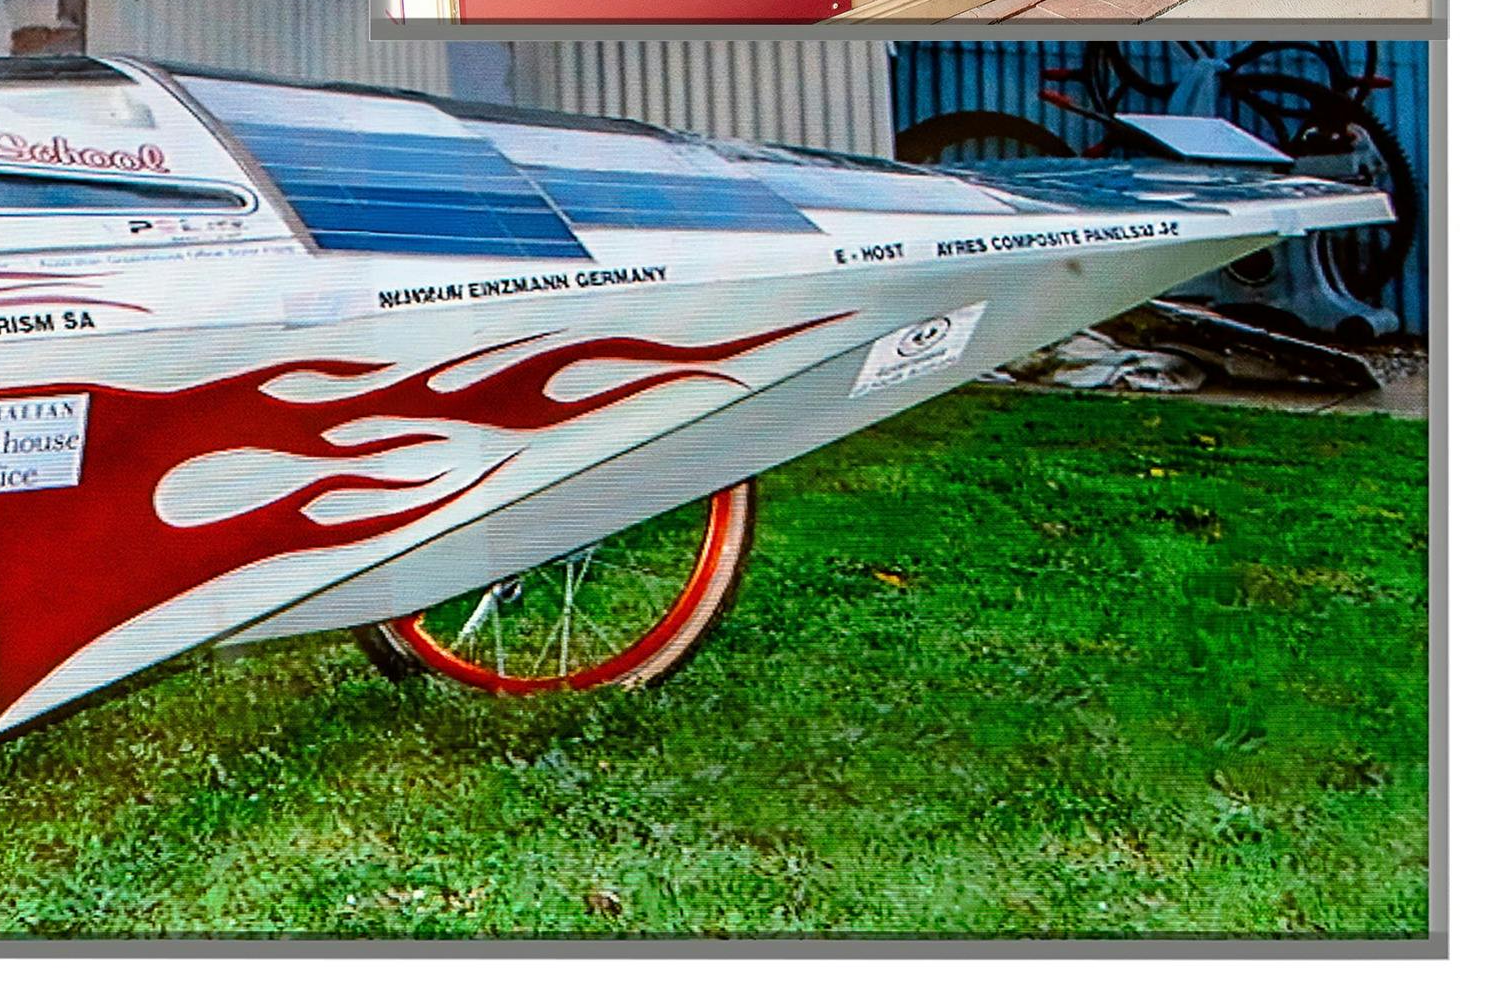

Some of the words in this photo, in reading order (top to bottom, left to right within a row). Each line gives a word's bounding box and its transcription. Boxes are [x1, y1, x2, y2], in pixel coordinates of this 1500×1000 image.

[991, 229, 1082, 252] COMPOSITE
[834, 248, 846, 264] E
[862, 243, 904, 263] HOST
[575, 266, 667, 288] GERMANY
[62, 310, 95, 329] SA
